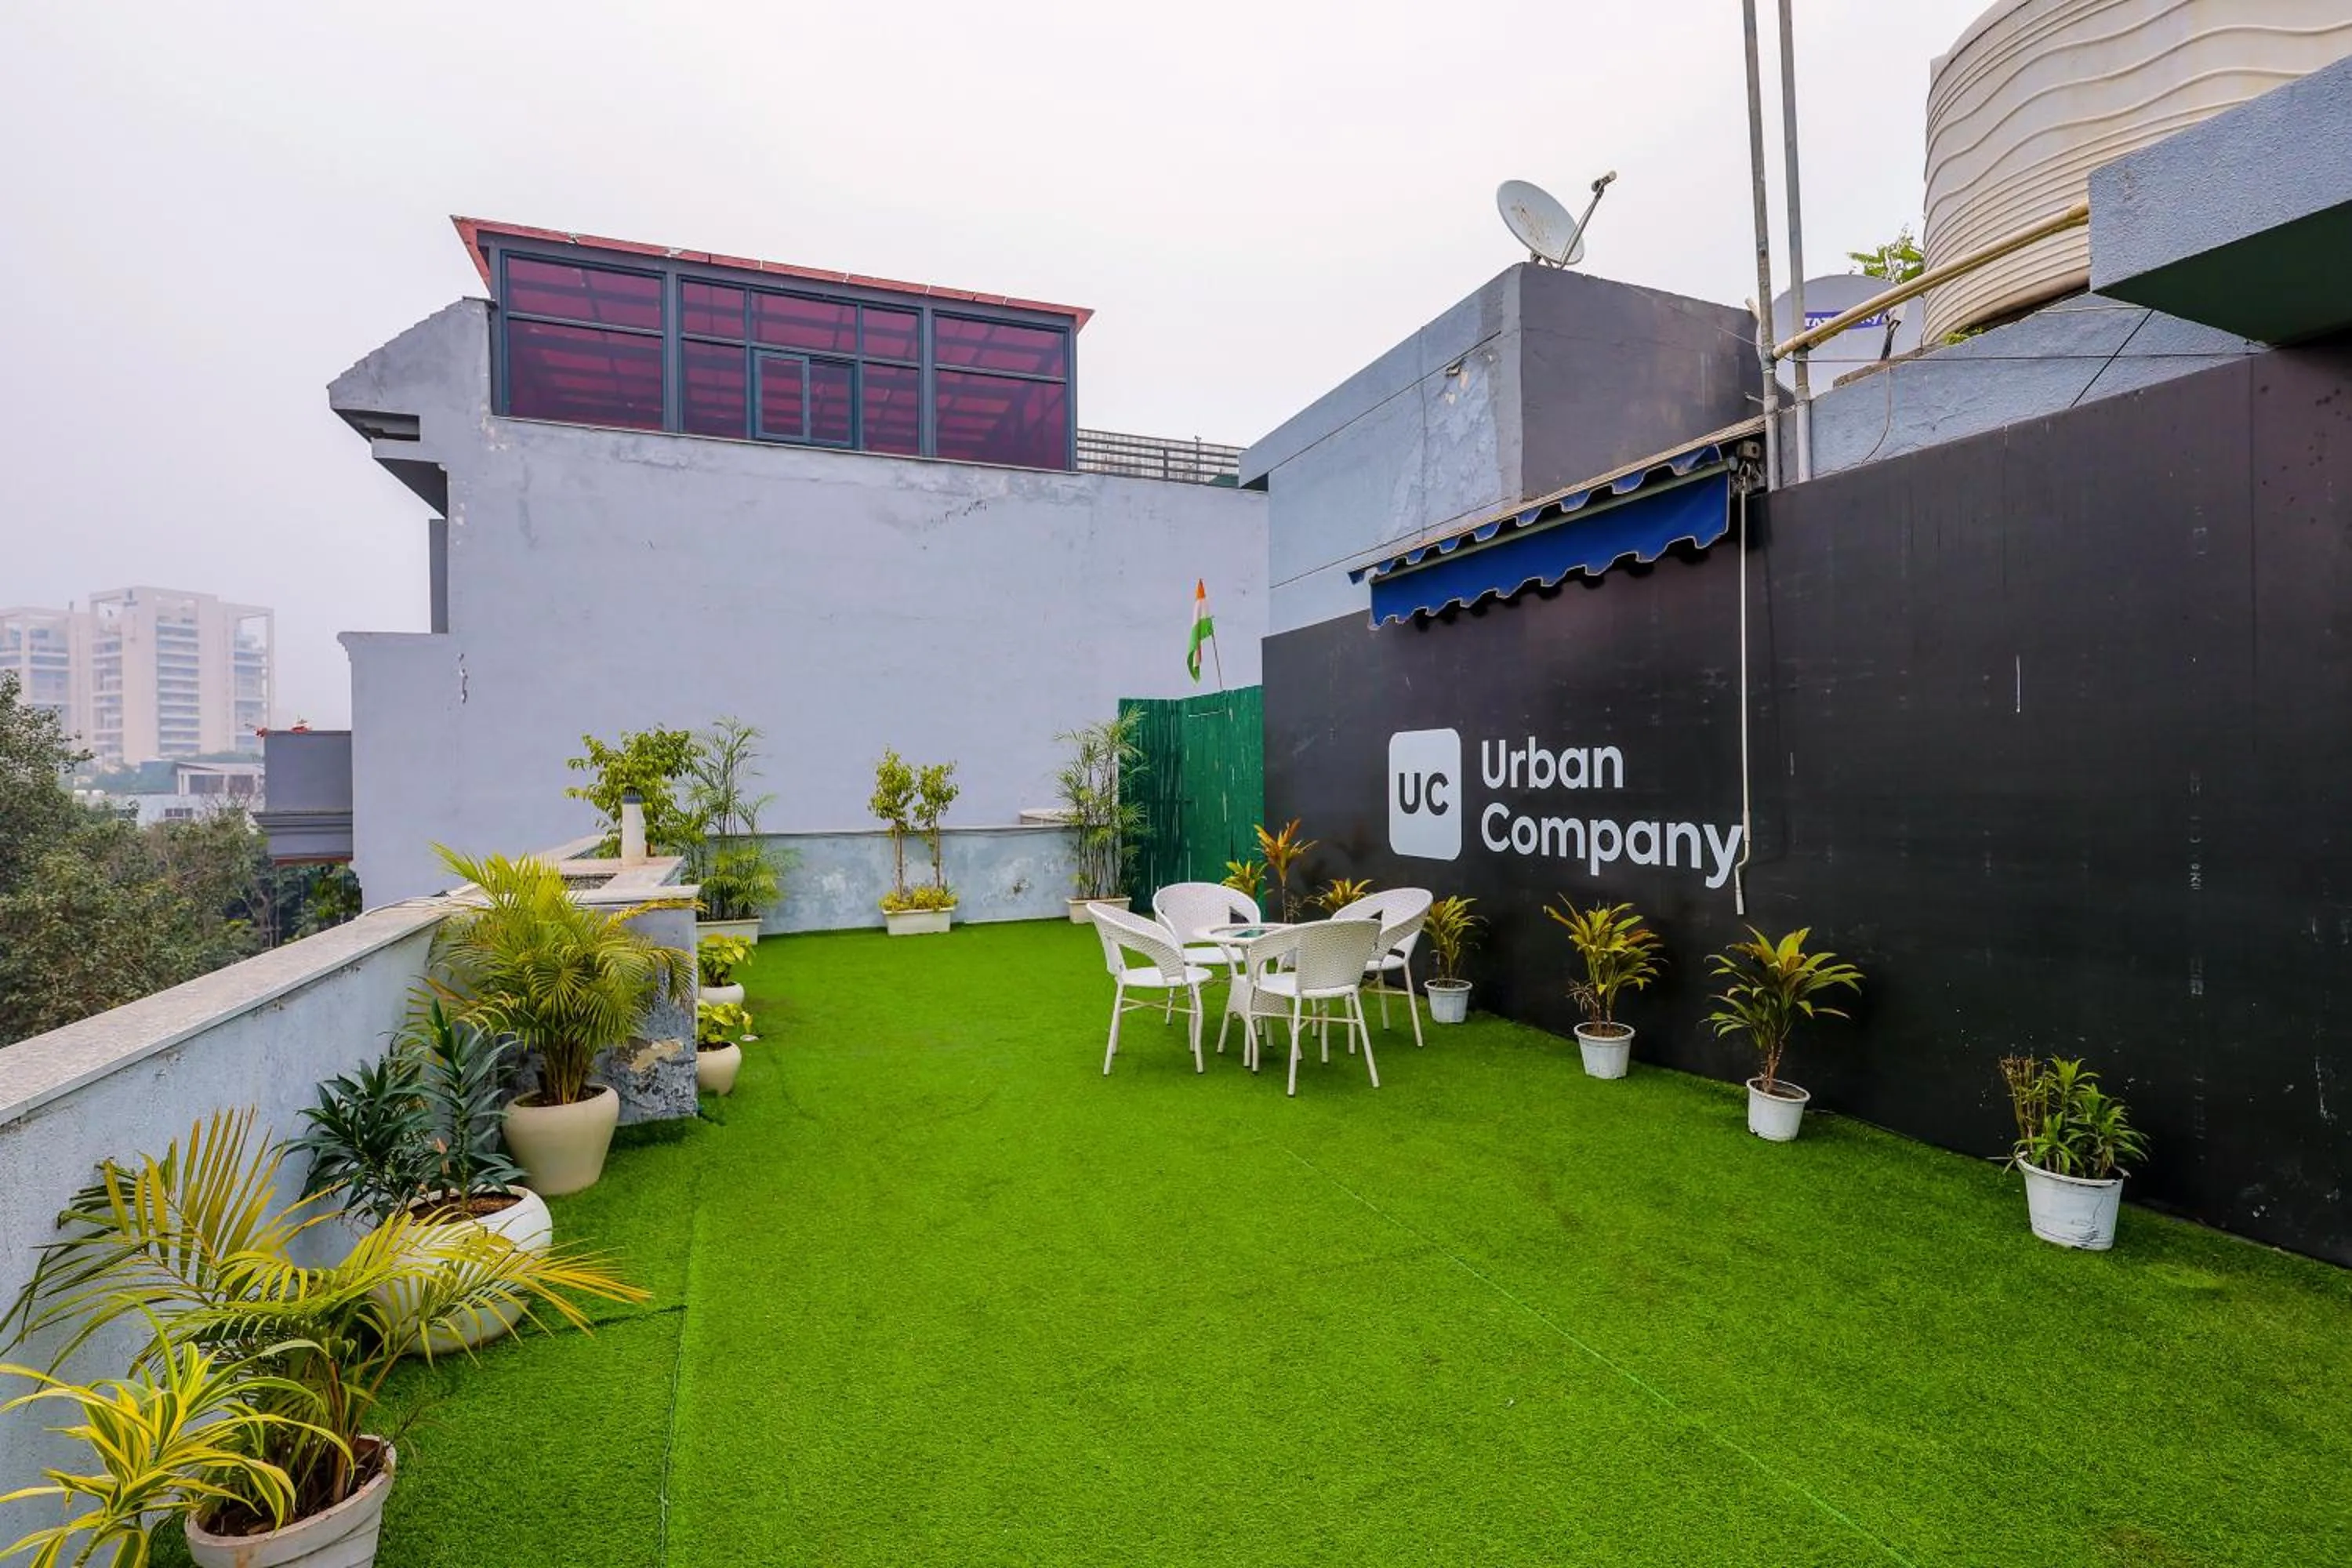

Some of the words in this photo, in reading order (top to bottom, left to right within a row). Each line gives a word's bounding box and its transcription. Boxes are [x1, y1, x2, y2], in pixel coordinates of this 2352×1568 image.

[1481, 735, 1624, 789] Urban
[1398, 771, 1450, 816] UC
[1481, 801, 1743, 889] Company
